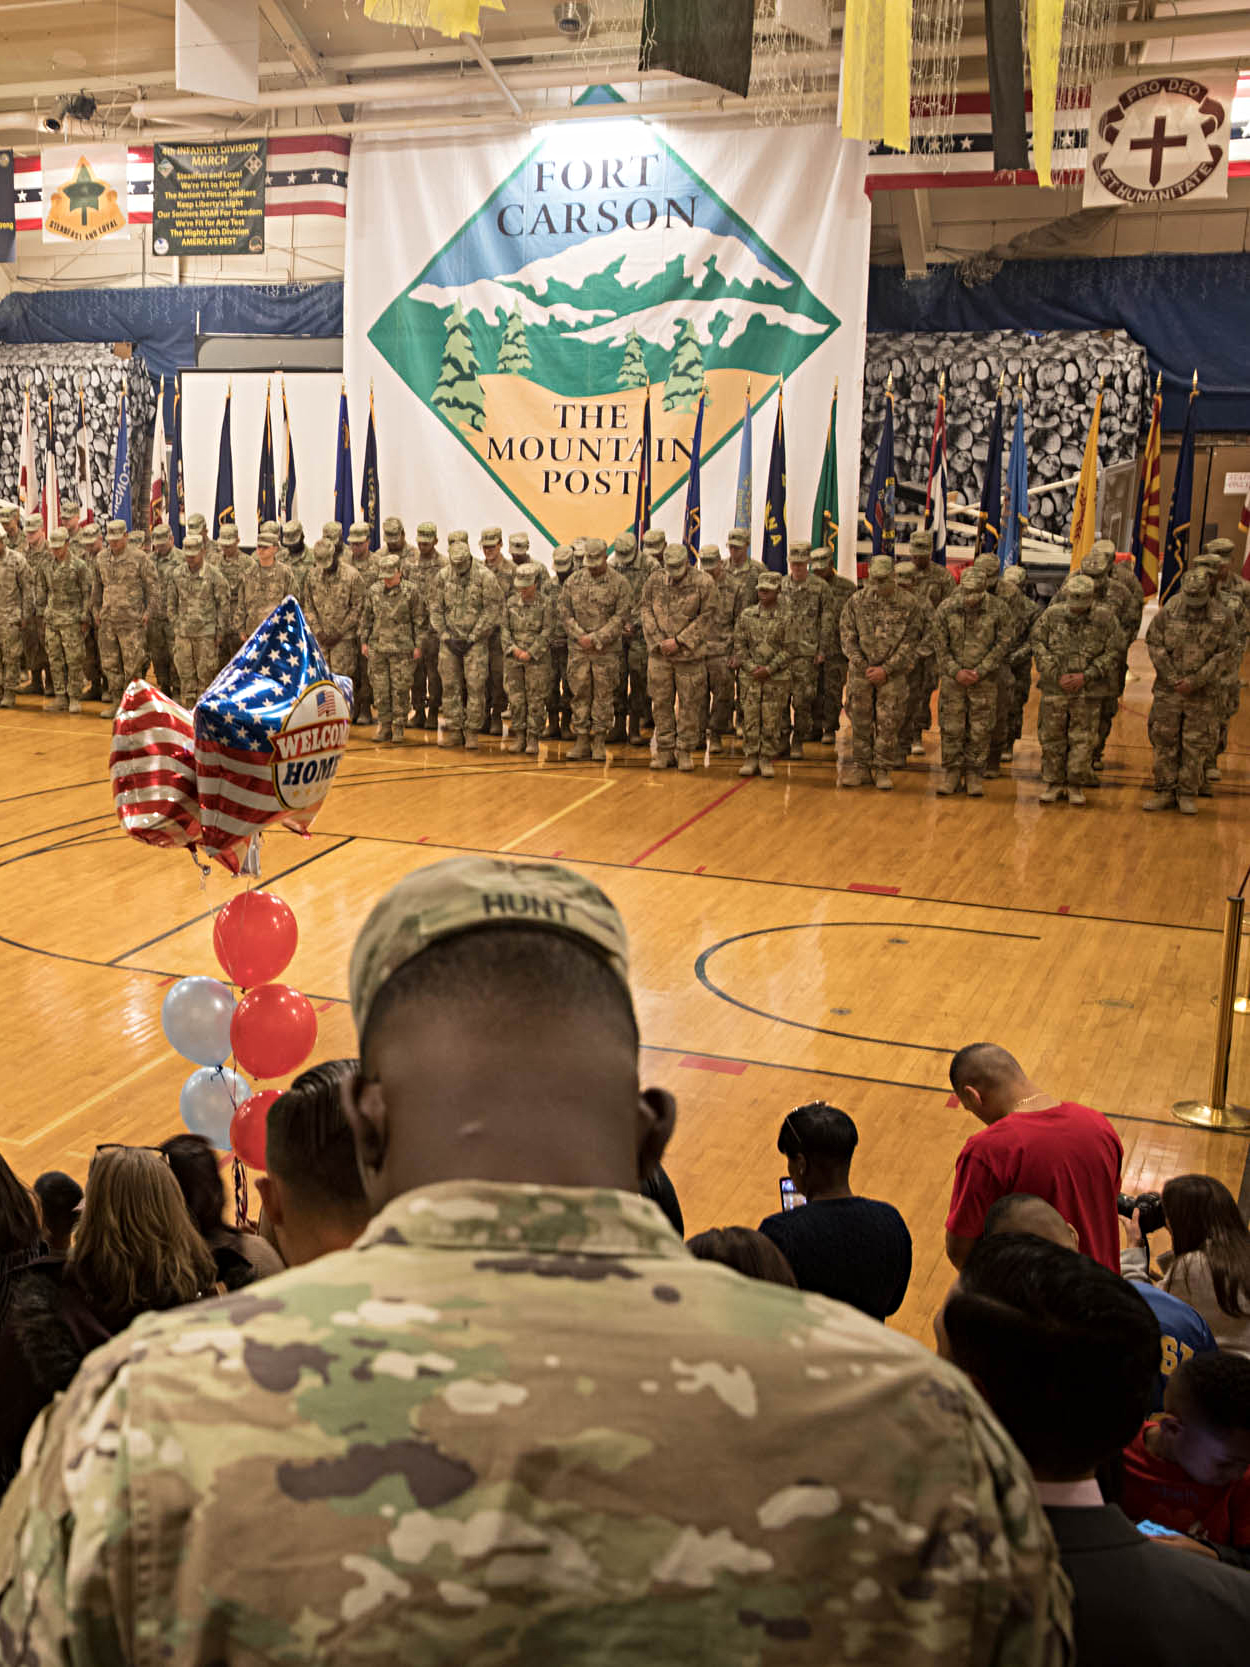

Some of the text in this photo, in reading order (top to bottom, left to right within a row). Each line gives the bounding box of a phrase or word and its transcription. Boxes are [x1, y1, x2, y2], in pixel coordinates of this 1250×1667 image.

[1126, 79, 1201, 102] PRO DEO
[177, 146, 218, 156] INFANTRY
[220, 144, 258, 153] DIVISION
[192, 156, 228, 167] MARCH
[534, 154, 660, 192] FORT
[1101, 162, 1212, 202] ET HUMANITATE
[497, 195, 699, 237] CARSON
[49, 219, 118, 240] STEADFAST AND LOYAL
[553, 404, 628, 429] THE
[487, 436, 694, 462] MOUNTAIN
[541, 470, 638, 495] POST
[276, 720, 350, 761] WELCOM
[482, 893, 567, 921] HUNT
